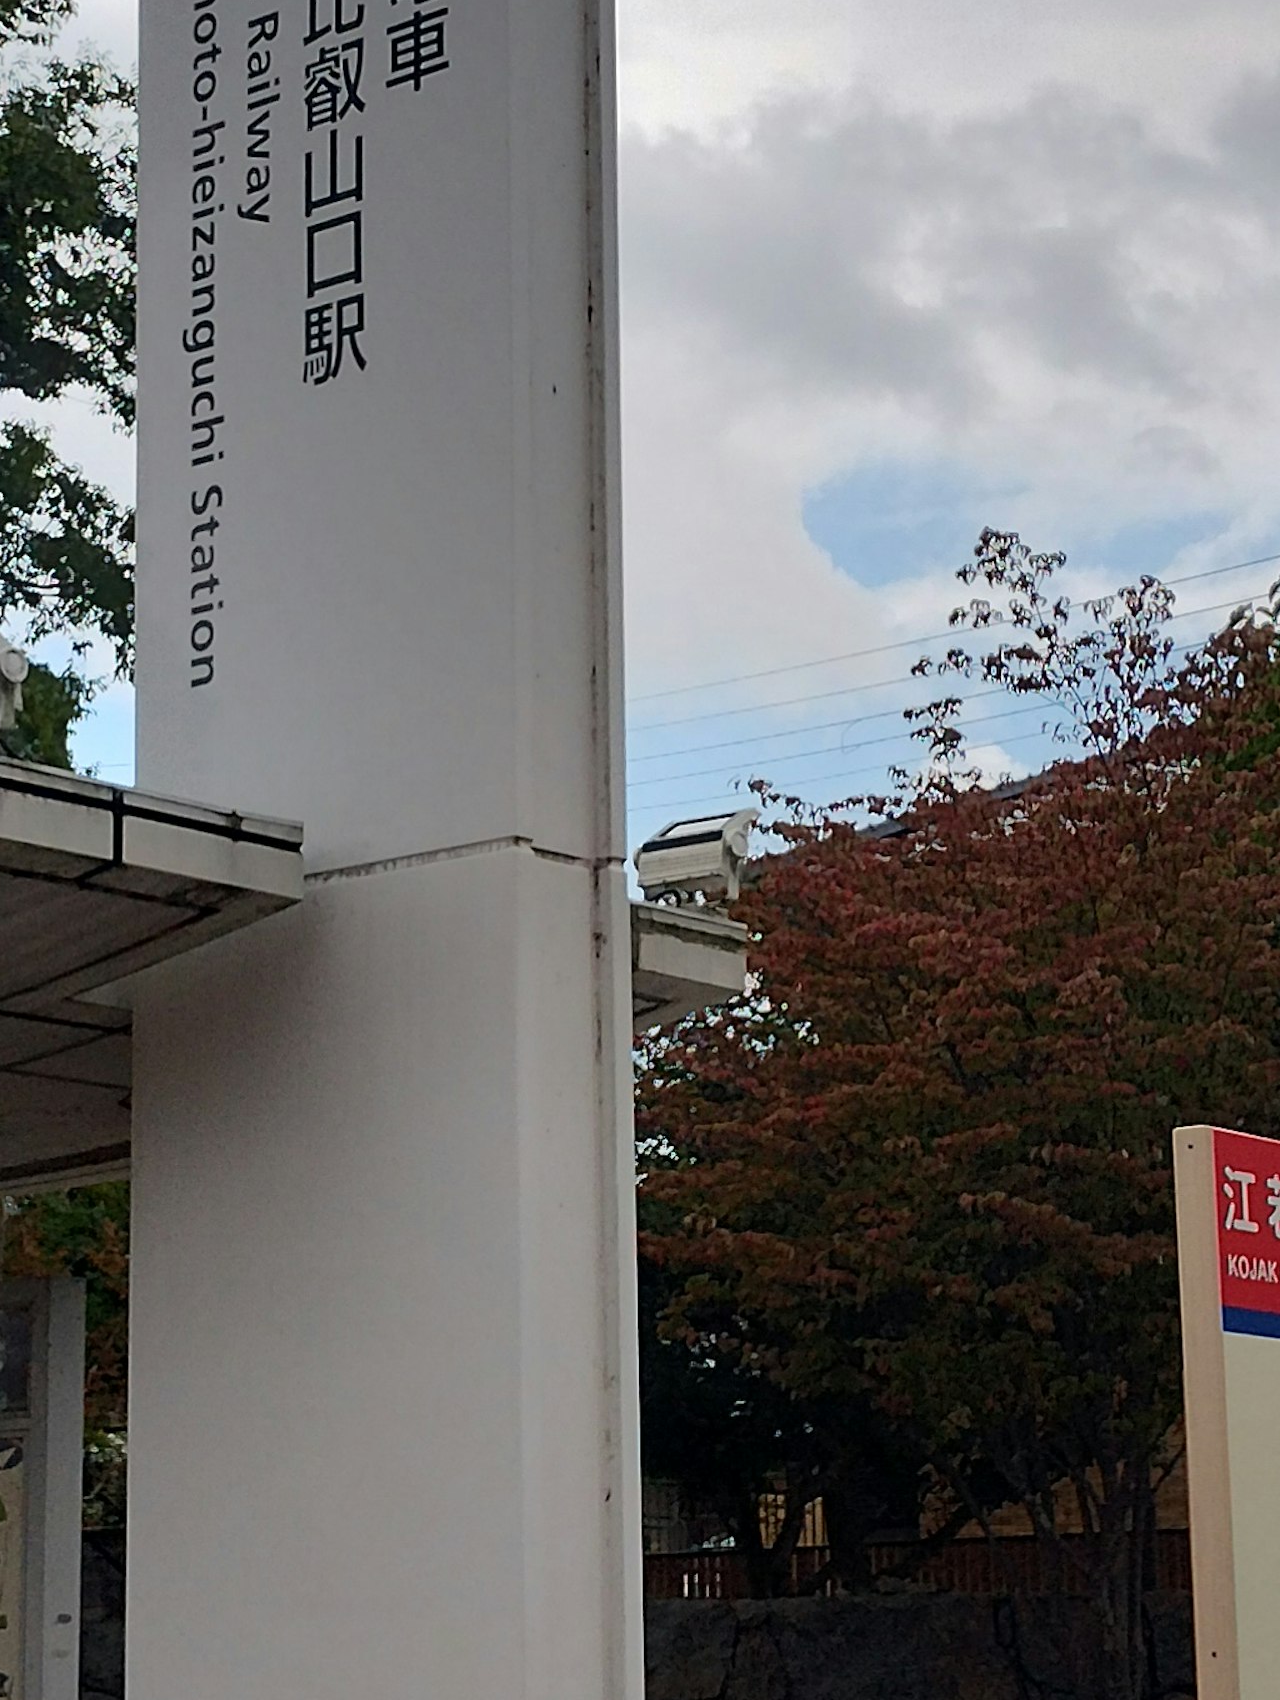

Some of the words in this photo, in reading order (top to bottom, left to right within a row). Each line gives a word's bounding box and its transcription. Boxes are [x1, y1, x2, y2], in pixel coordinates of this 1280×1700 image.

[237, 11, 282, 223] Railway
[189, 483, 224, 689] Station
[1227, 1253, 1279, 1284] KOJAK
